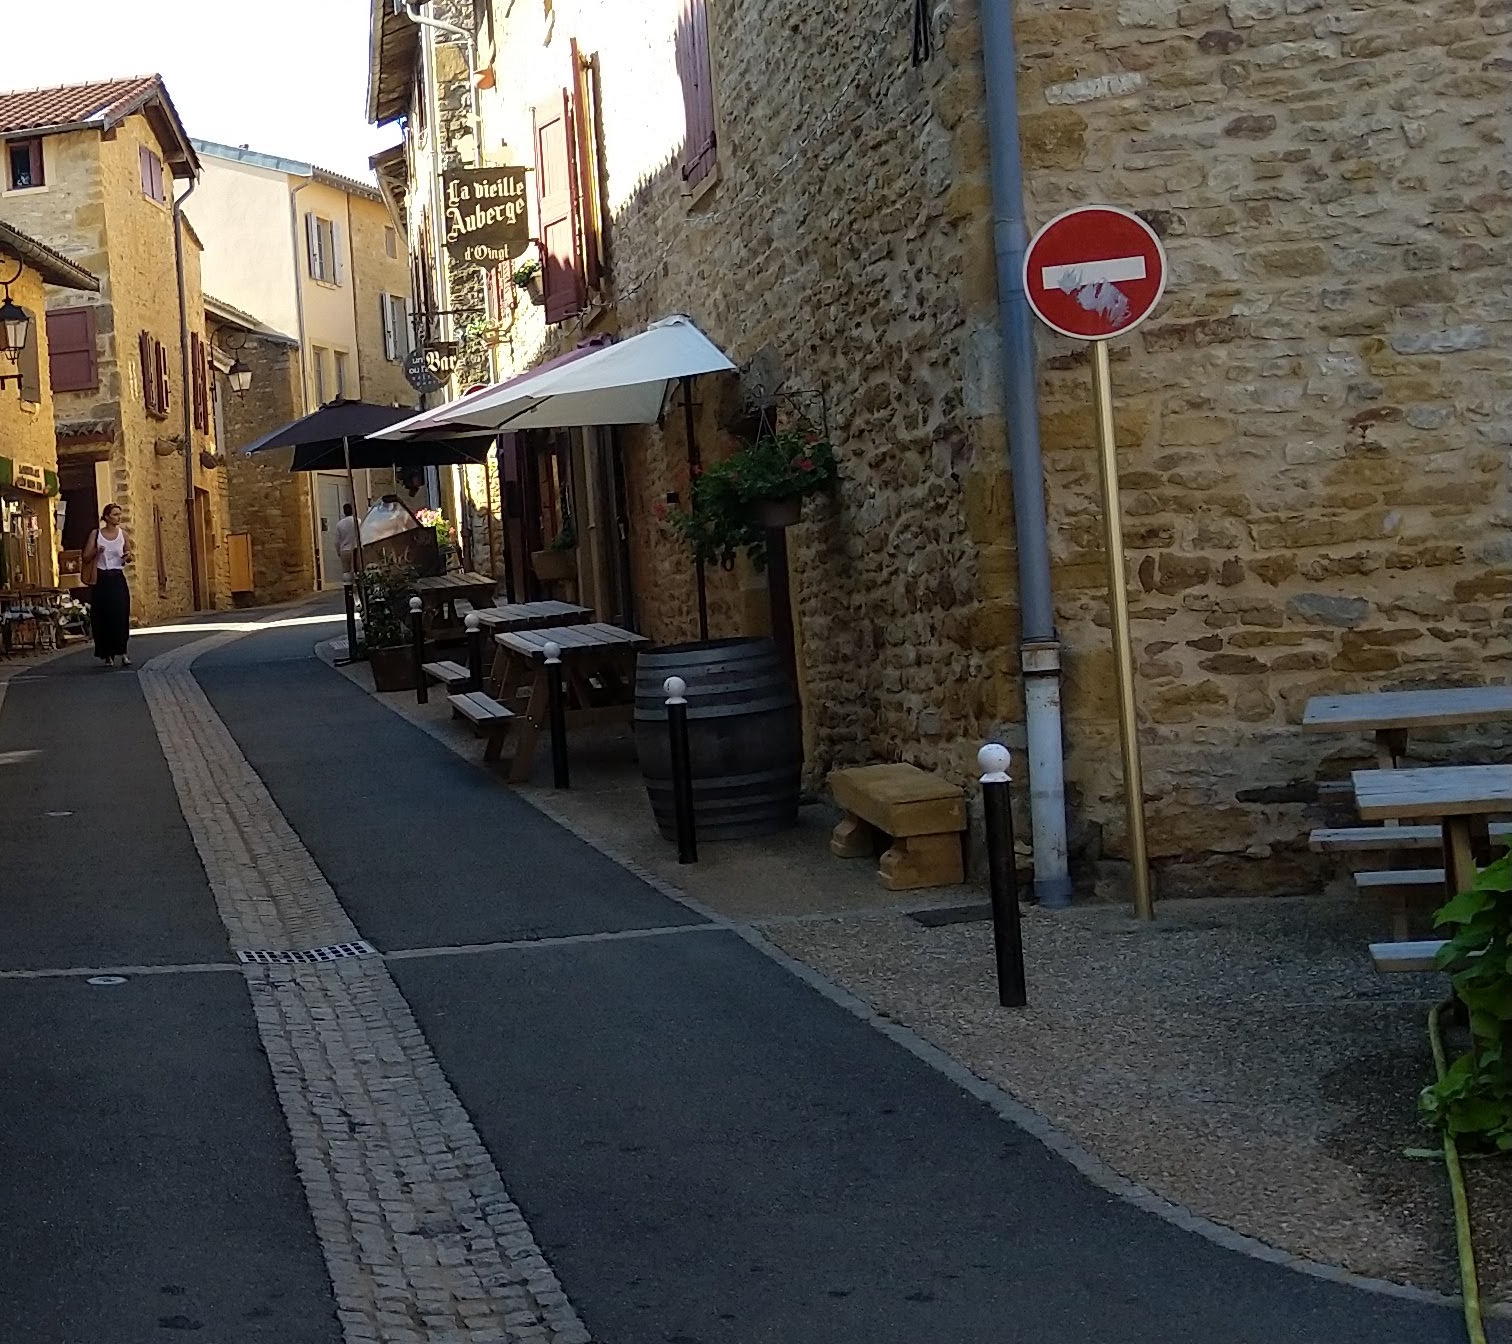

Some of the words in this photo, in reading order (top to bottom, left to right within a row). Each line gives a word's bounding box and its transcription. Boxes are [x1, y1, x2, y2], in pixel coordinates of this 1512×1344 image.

[446, 179, 470, 207] La
[473, 176, 525, 198] vieille
[446, 197, 525, 242] Auberge
[464, 243, 509, 261] d'Oingt
[425, 350, 457, 372] Bar
